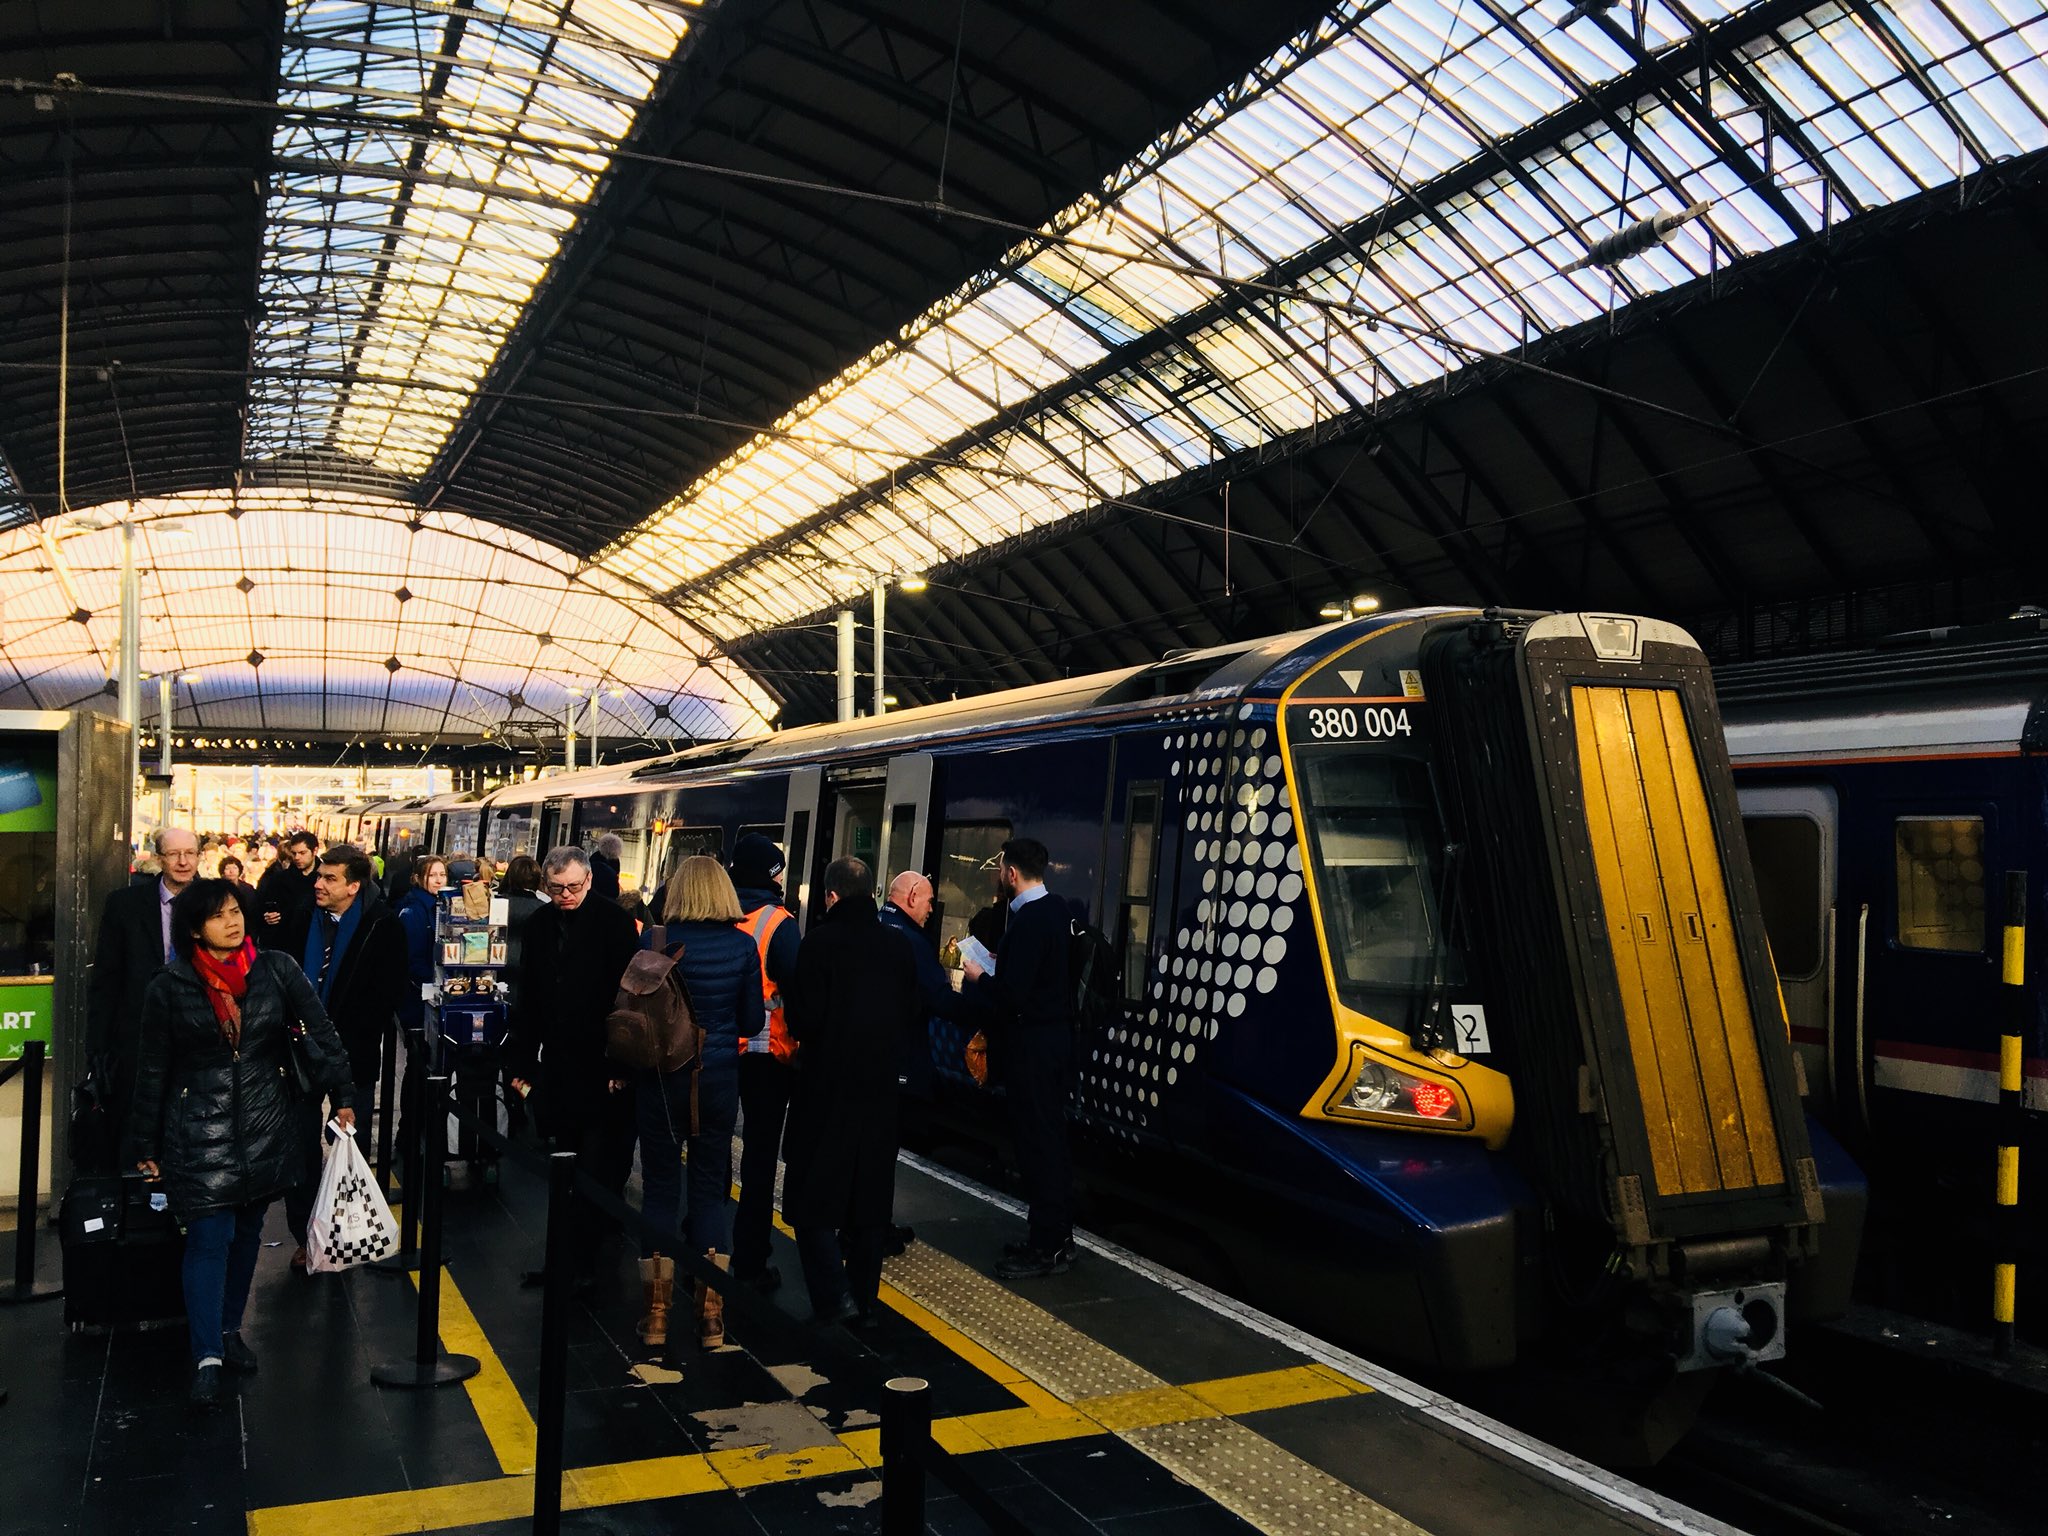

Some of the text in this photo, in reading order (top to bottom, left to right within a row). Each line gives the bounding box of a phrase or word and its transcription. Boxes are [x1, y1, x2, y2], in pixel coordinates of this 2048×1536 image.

[1308, 707, 1412, 738] 380 004
[1462, 1014, 1481, 1042] 2
